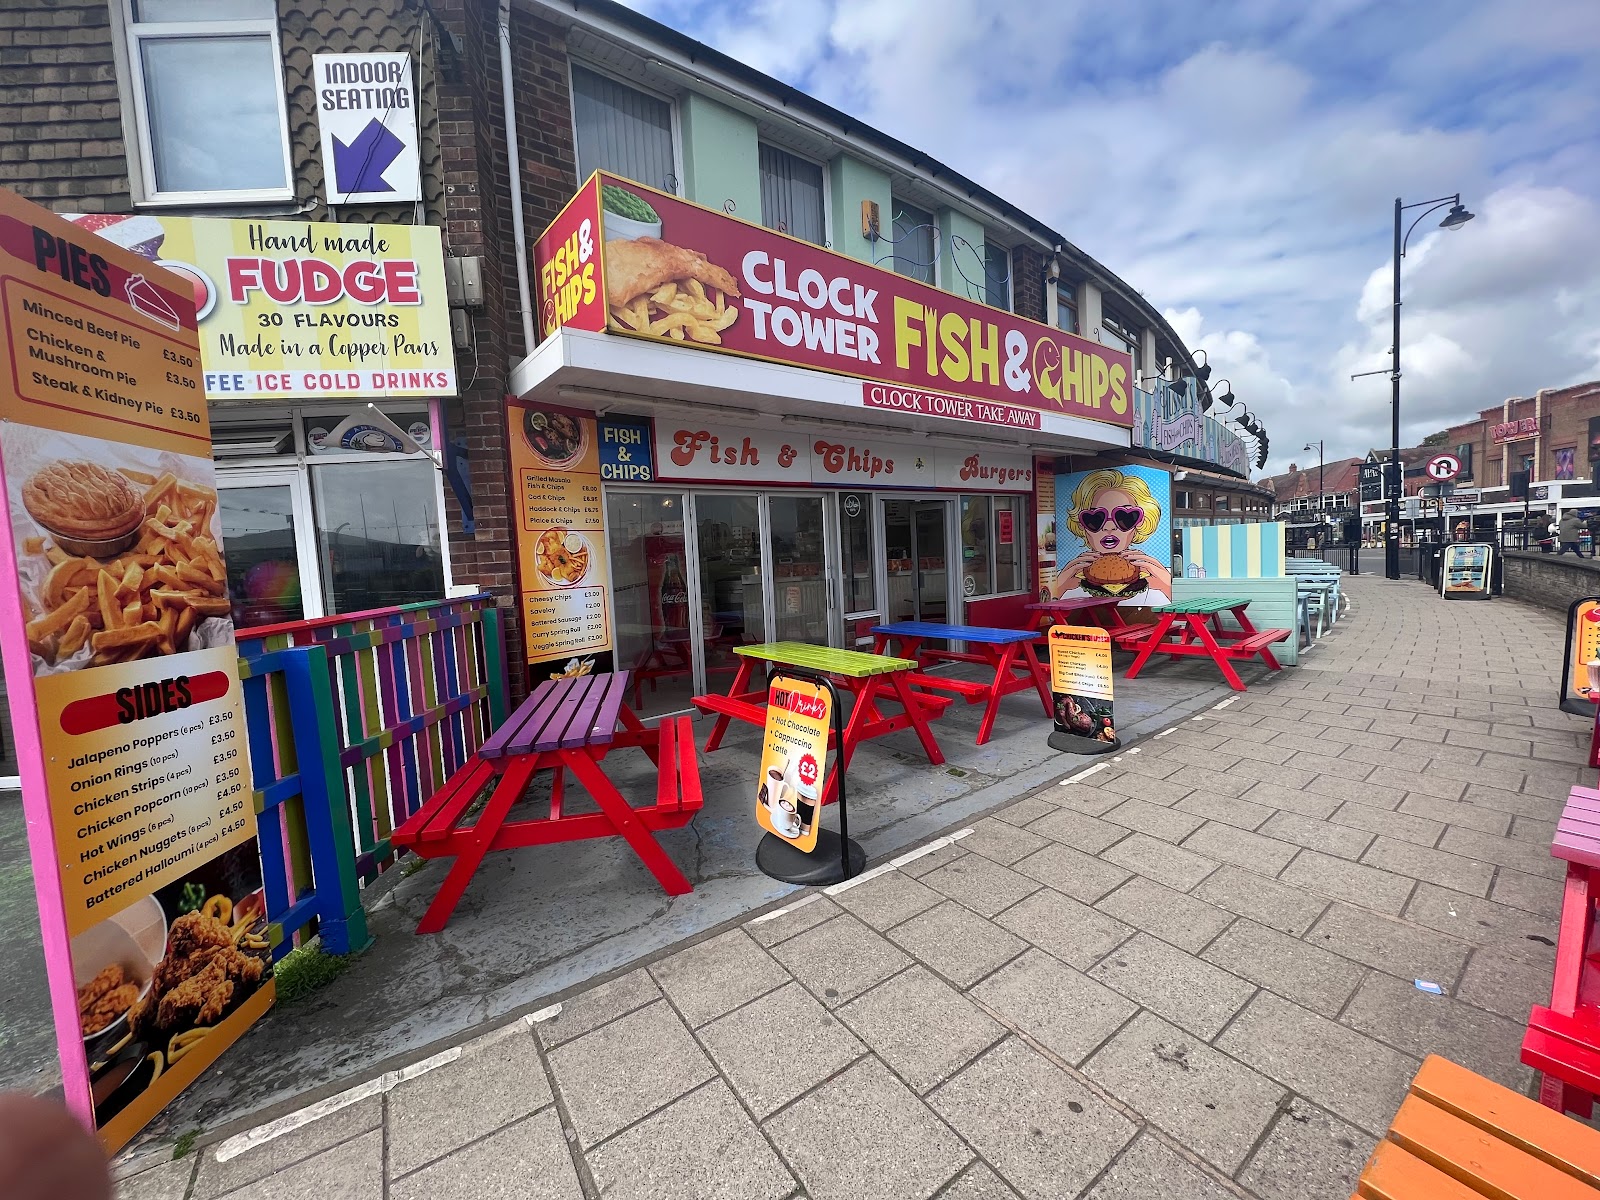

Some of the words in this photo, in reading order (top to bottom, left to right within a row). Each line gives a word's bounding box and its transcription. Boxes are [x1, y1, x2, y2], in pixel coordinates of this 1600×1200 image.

[325, 61, 402, 84] INDOOR
[322, 87, 410, 111] SEATING
[249, 224, 317, 253] Hand
[324, 226, 390, 255] made
[32, 225, 111, 297] PIES
[542, 230, 579, 302] FISH
[579, 218, 593, 264] &
[227, 257, 420, 304] FUDGE
[742, 250, 880, 324] CLOCK
[23, 298, 84, 331] Minced
[87, 320, 119, 342] Beef
[121, 335, 141, 350] Pie
[257, 312, 284, 328] 30
[294, 313, 400, 328] FLAVOURS
[744, 297, 883, 366] TOWER
[26, 327, 93, 359] Chicken
[96, 350, 106, 363] &
[162, 349, 193, 368] £3.50
[219, 333, 276, 357] Made
[280, 339, 304, 357] in
[308, 343, 324, 356] a
[328, 333, 390, 363] Copper
[393, 333, 440, 357] Pans
[893, 295, 1001, 387] FISH
[1003, 328, 1033, 395] &
[1032, 335, 1129, 417] CHIPS
[29, 345, 115, 381] Mushroom
[117, 372, 137, 387] Pie
[166, 371, 196, 390] £3.50
[206, 374, 245, 391] FEE
[256, 373, 293, 391] ICE
[303, 373, 361, 390] COLD
[372, 372, 449, 390] DRINKS
[32, 371, 79, 395] Steak
[81, 385, 93, 398] &
[94, 387, 143, 414] Kidney
[145, 399, 164, 416] Pie
[170, 407, 201, 425] £3.50
[870, 386, 922, 412] CLOCK
[925, 395, 974, 419] TOWER
[976, 403, 1006, 423] TAKE
[1006, 409, 1037, 427] AWAY
[603, 427, 641, 445] FISH
[1489, 417, 1537, 439] TOWER
[617, 446, 633, 462] &
[671, 429, 760, 467] Fish
[777, 444, 798, 469] &
[814, 440, 895, 480] Chips
[959, 452, 1033, 485] Burgers
[600, 463, 651, 481] CHIPS
[546, 484, 565, 493] Chips
[547, 494, 566, 503] Chips
[555, 517, 573, 526] Chips
[563, 507, 581, 515] Chips
[529, 595, 554, 604] Cheesy
[554, 594, 572, 602] Chips
[530, 607, 556, 615] Saveloy
[531, 617, 557, 627] Battered
[558, 615, 582, 624] Sausage
[532, 631, 550, 639] Curry
[550, 628, 570, 637] Spring
[587, 623, 602, 631] £2.00
[533, 642, 555, 651] Veggie
[555, 638, 575, 647] Spring
[588, 634, 603, 642] £2.00
[115, 675, 192, 725] SIDES
[775, 690, 789, 707] HOT
[788, 690, 826, 718] Drinks
[67, 743, 131, 770] Jalapeno
[132, 728, 180, 751] Poppers
[180, 726, 188, 736] (6
[189, 720, 204, 736] pcs)
[208, 711, 233, 726] £3.50
[774, 729, 812, 750] Cappuccino
[775, 715, 786, 727] Hot
[786, 719, 821, 738] Chocolate
[70, 773, 112, 793] Onion
[114, 757, 149, 781] Rings
[150, 755, 161, 767] (10
[161, 749, 179, 765] pcs)
[211, 730, 235, 745] £3.50
[772, 742, 788, 756] Latte
[73, 789, 130, 817] Chicken
[130, 773, 166, 795] Strips
[166, 770, 175, 782] (4
[175, 765, 192, 781] pcs)
[213, 748, 238, 765] £3.50
[800, 761, 816, 780] £2
[77, 811, 132, 839] Chicken
[134, 789, 182, 815] Popcorn
[182, 786, 193, 797] (10
[193, 779, 209, 794] pcs)
[215, 767, 240, 784] £3.50
[80, 844, 105, 863] Hot
[106, 825, 147, 851] Wings
[157, 814, 175, 830] pcs)
[216, 783, 241, 800] £4.50
[83, 856, 138, 886] Chicken
[139, 829, 187, 859] Nuggets
[197, 817, 212, 832] pcs)
[219, 800, 244, 819] £4.50
[86, 873, 144, 910] Battered
[145, 844, 195, 880] Halloumi
[196, 841, 204, 853] (4
[204, 832, 219, 849] pcs)
[221, 818, 246, 838] £4.50
